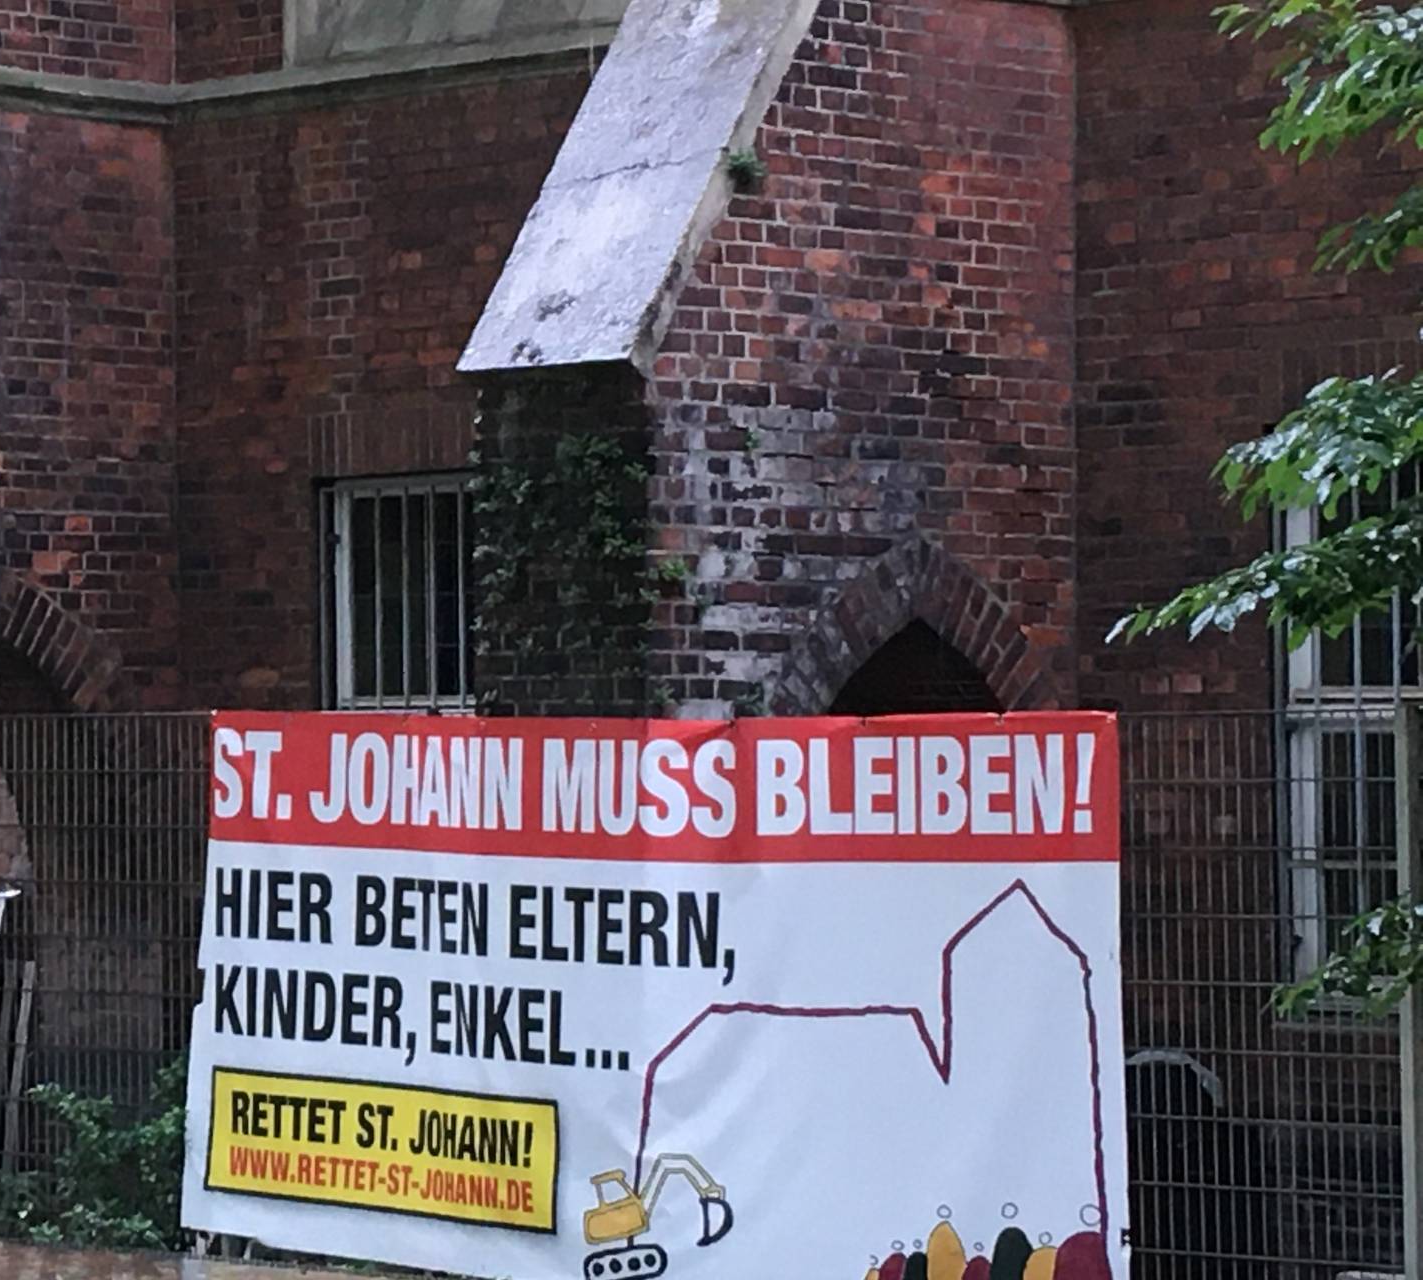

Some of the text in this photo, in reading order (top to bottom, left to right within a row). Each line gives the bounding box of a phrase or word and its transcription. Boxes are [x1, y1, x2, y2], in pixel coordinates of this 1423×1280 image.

[214, 729, 1095, 838] ST. JOHANN MUSS BLEIBEN!
[215, 867, 737, 985] HIER BETEN ELTERN,
[215, 965, 631, 1071] KINDER, ENKEL...
[229, 1146, 533, 1213] WWW.RETTET-ST-JOHANN.DE
[230, 1091, 533, 1168] RETTET ST. JOHANN!
